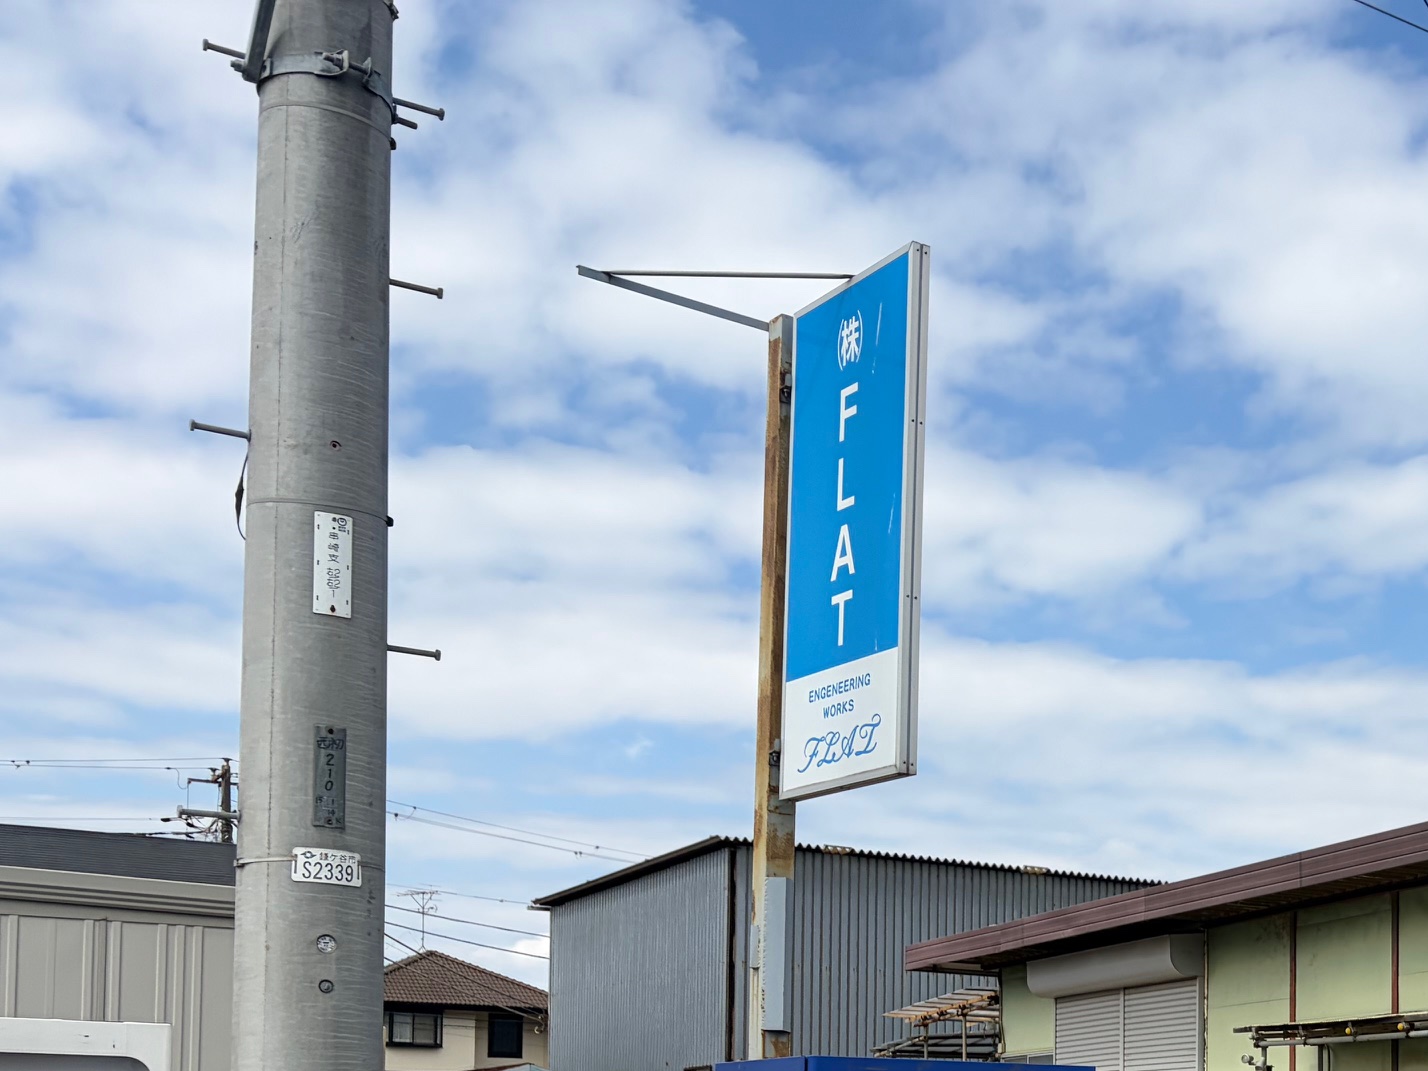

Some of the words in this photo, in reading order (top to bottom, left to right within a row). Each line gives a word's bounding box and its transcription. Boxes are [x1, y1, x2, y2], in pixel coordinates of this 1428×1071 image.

[808, 673, 871, 703] ENGENEERING
[823, 699, 855, 718] WORKS
[797, 713, 882, 773] FLAT
[302, 861, 354, 882] S2339
